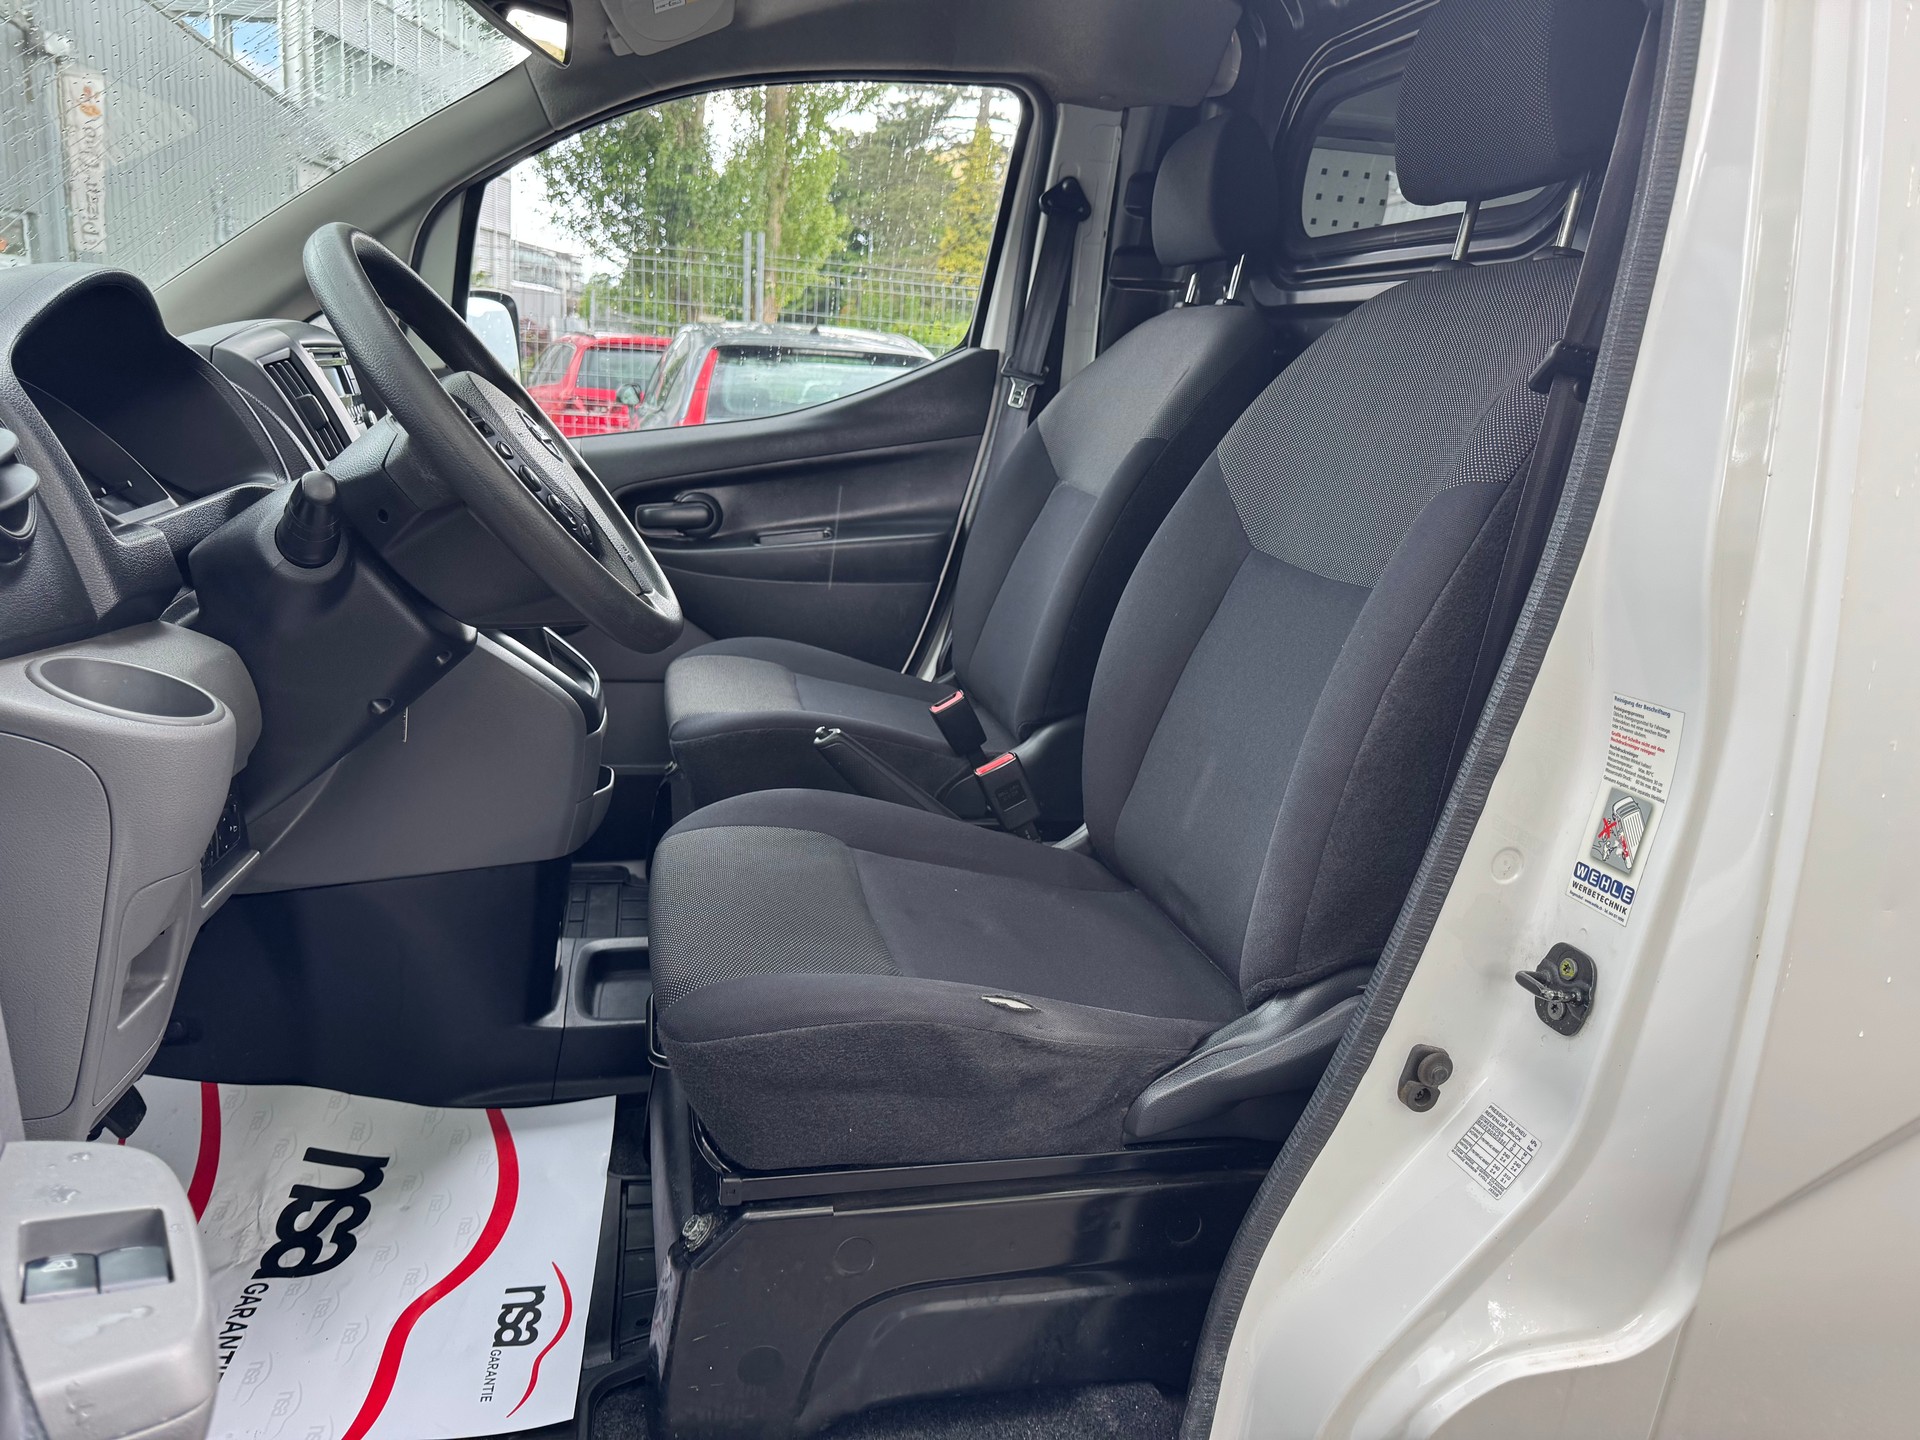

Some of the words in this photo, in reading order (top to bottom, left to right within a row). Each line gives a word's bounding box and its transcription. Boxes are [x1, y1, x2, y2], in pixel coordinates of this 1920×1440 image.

[1572, 881, 1627, 915] WERBETECHNIK
[1575, 863, 1634, 904] WEHLE
[1485, 1110, 1507, 1130] REIFENLUFT
[1507, 1129, 1522, 1142] DRUCK
[1488, 1105, 1508, 1123] PRESSION
[1515, 1127, 1527, 1138] PNEU
[251, 1147, 391, 1280] nsa
[218, 1282, 270, 1383] GARANT
[492, 1285, 547, 1348] nsa
[480, 1348, 502, 1404] GARANTIE
